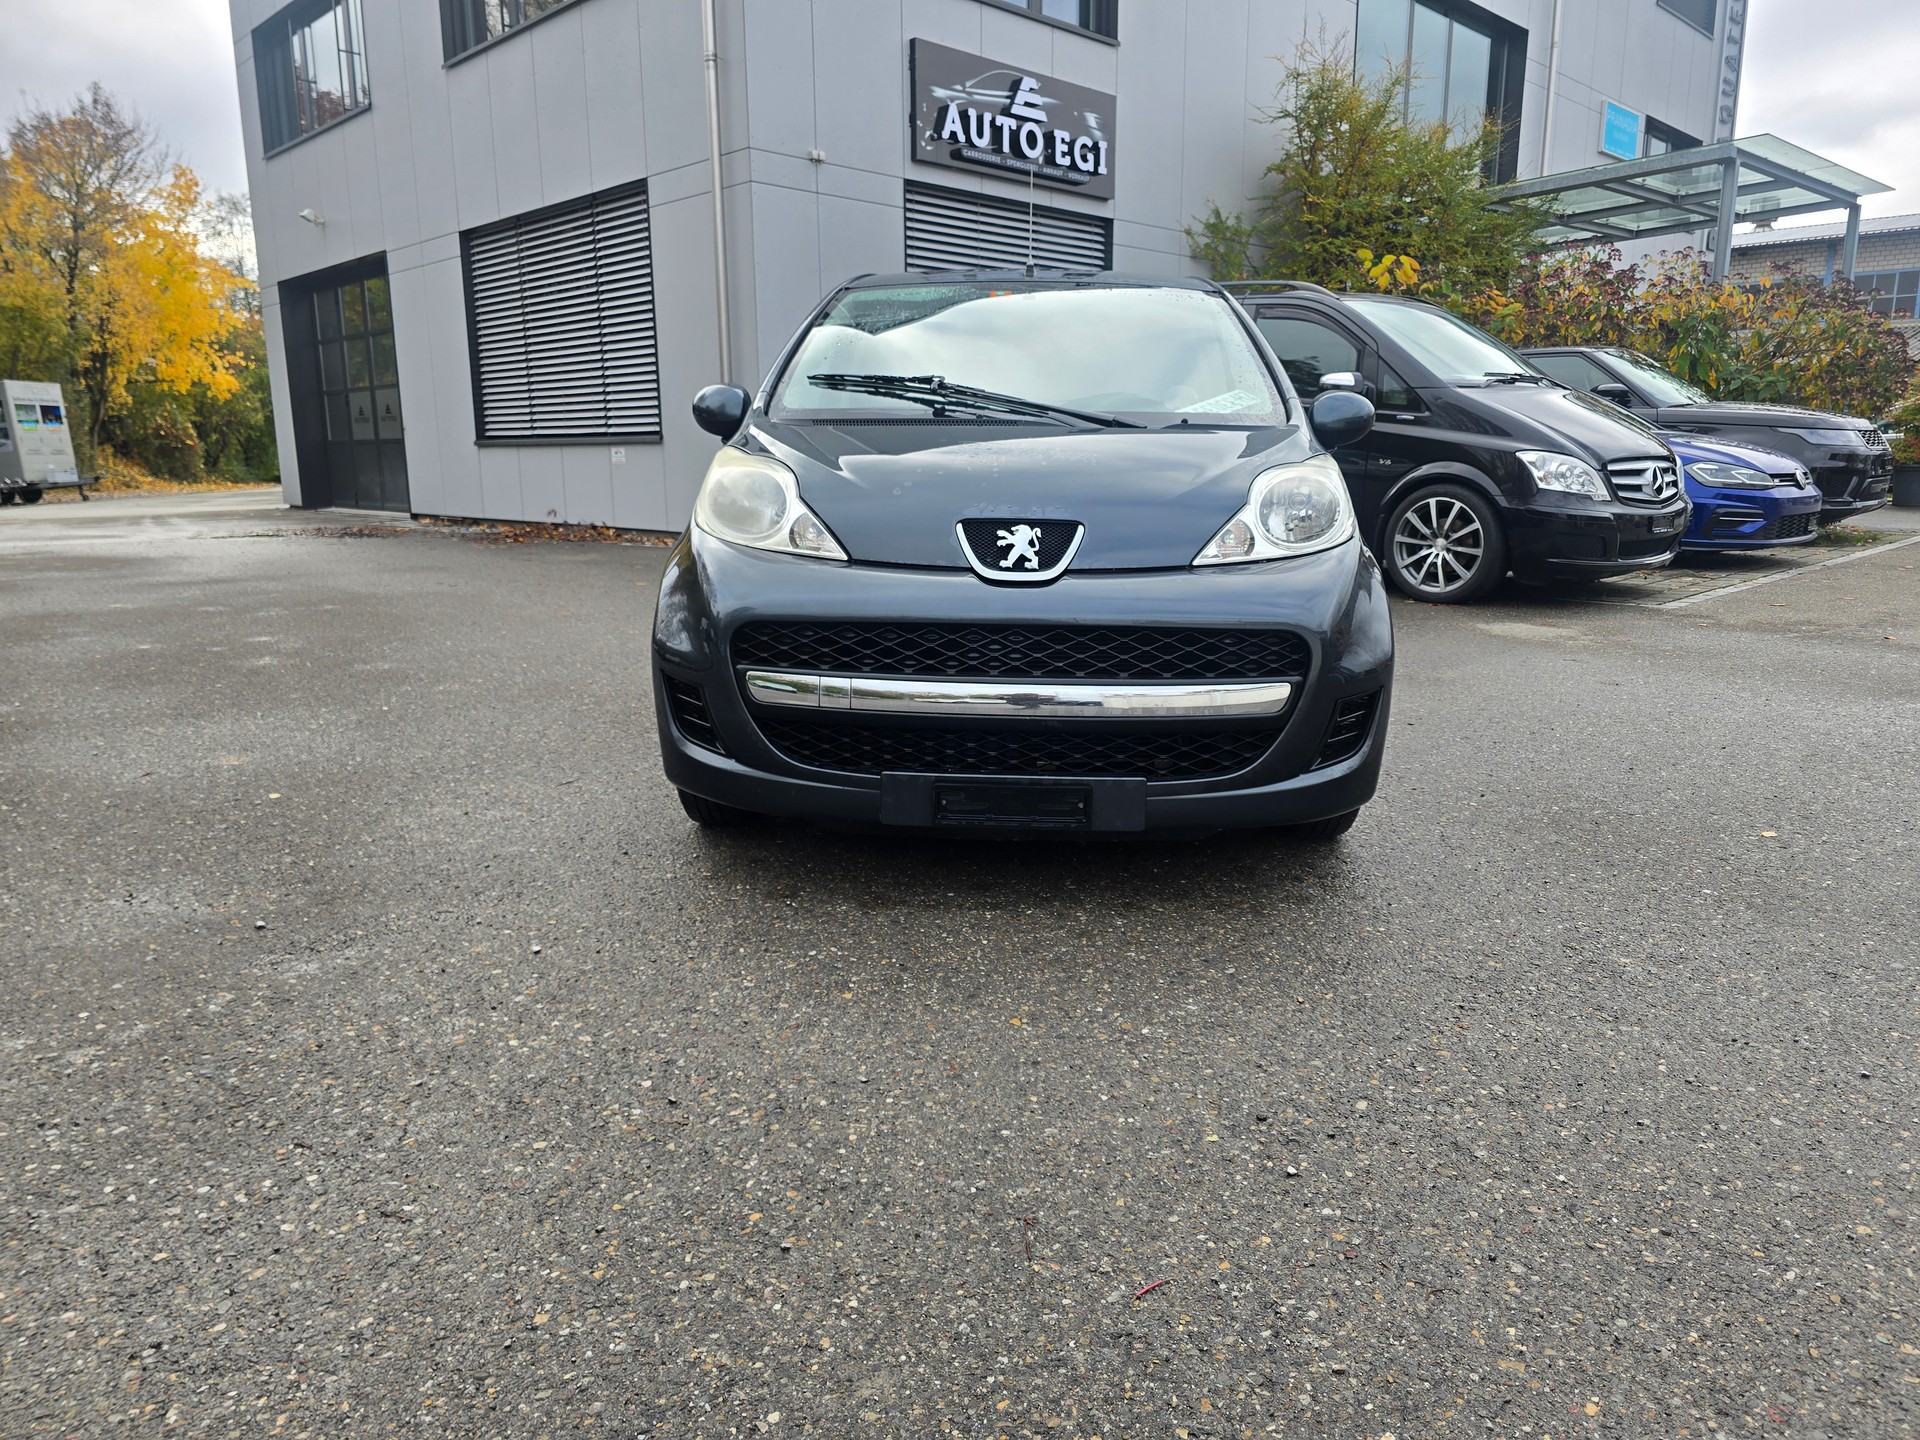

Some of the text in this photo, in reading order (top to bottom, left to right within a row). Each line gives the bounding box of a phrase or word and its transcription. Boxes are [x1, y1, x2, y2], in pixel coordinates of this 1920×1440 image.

[1718, 0, 1744, 142] QUATE
[942, 103, 1108, 175] AUTO EGI
